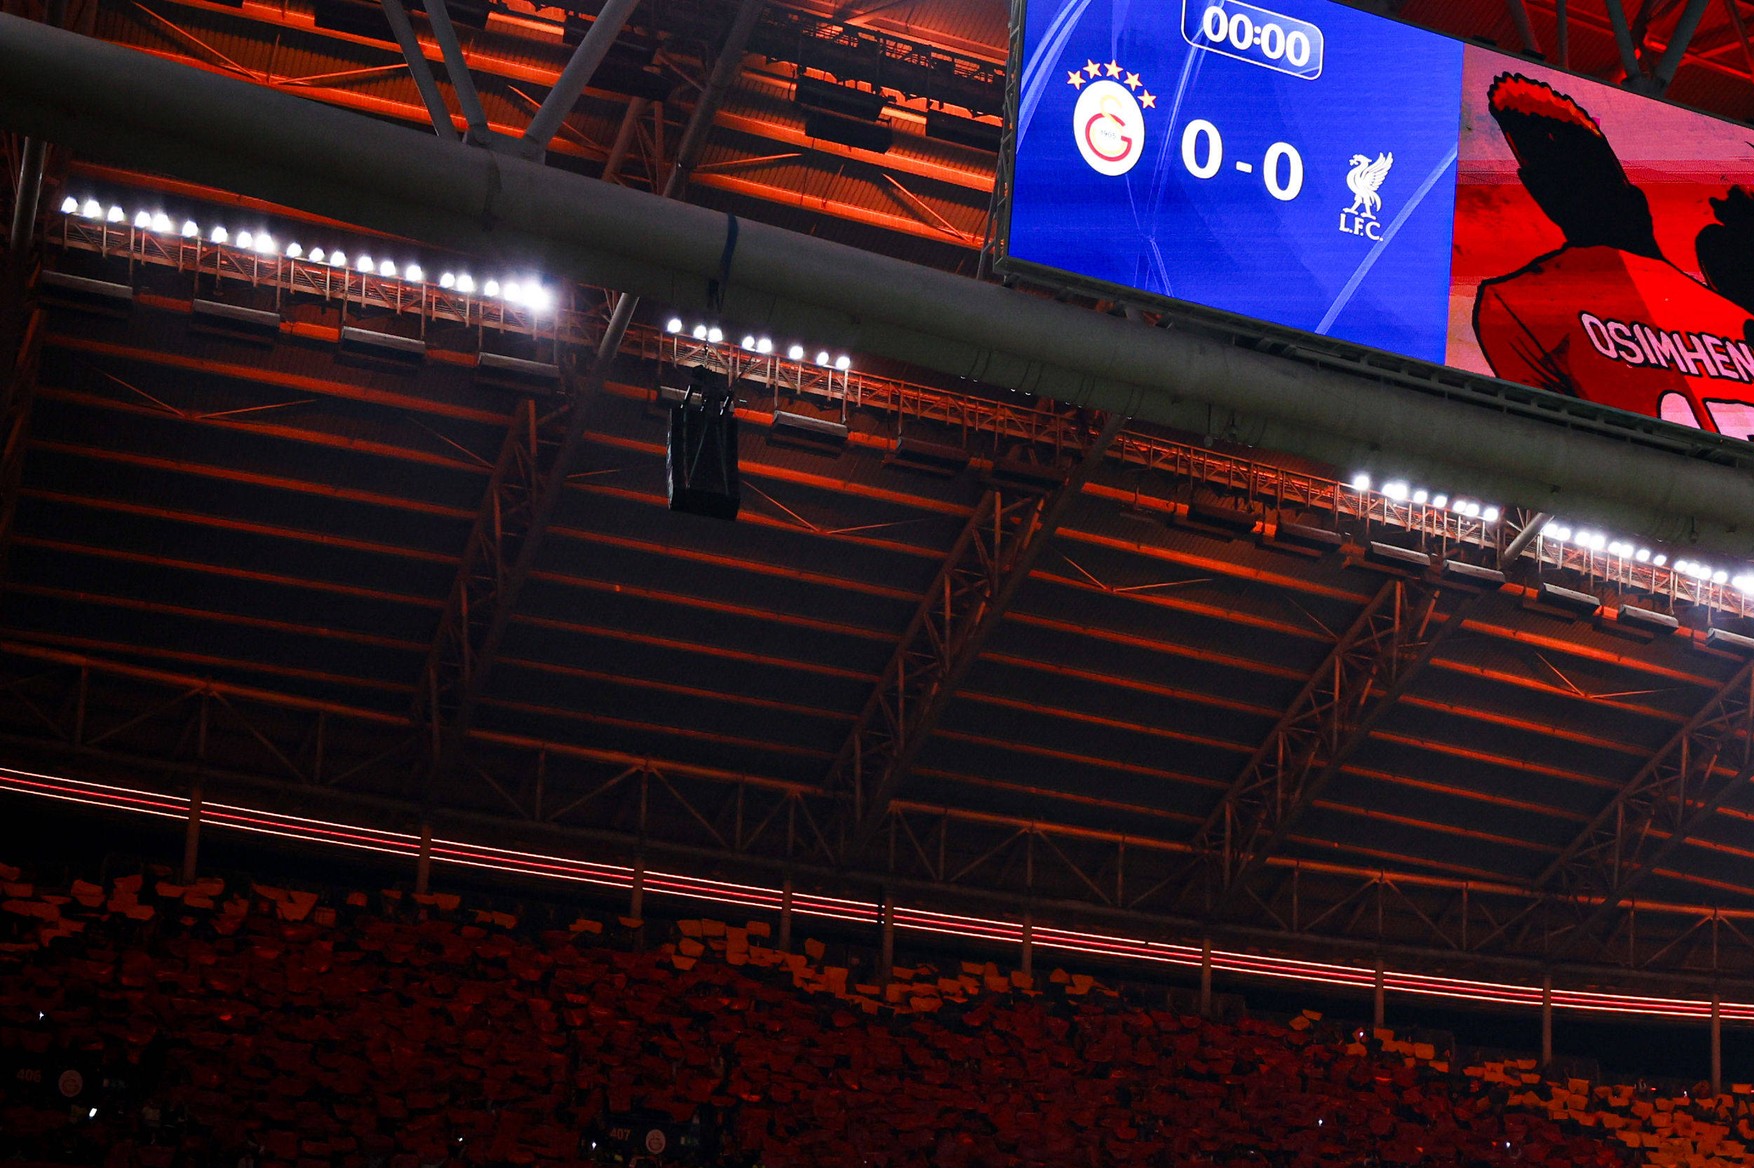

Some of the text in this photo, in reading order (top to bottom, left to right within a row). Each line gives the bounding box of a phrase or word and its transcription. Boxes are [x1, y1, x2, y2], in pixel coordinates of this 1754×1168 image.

[1203, 6, 1311, 67] 00:00
[1181, 119, 1223, 179] 0
[1263, 141, 1304, 201] 0
